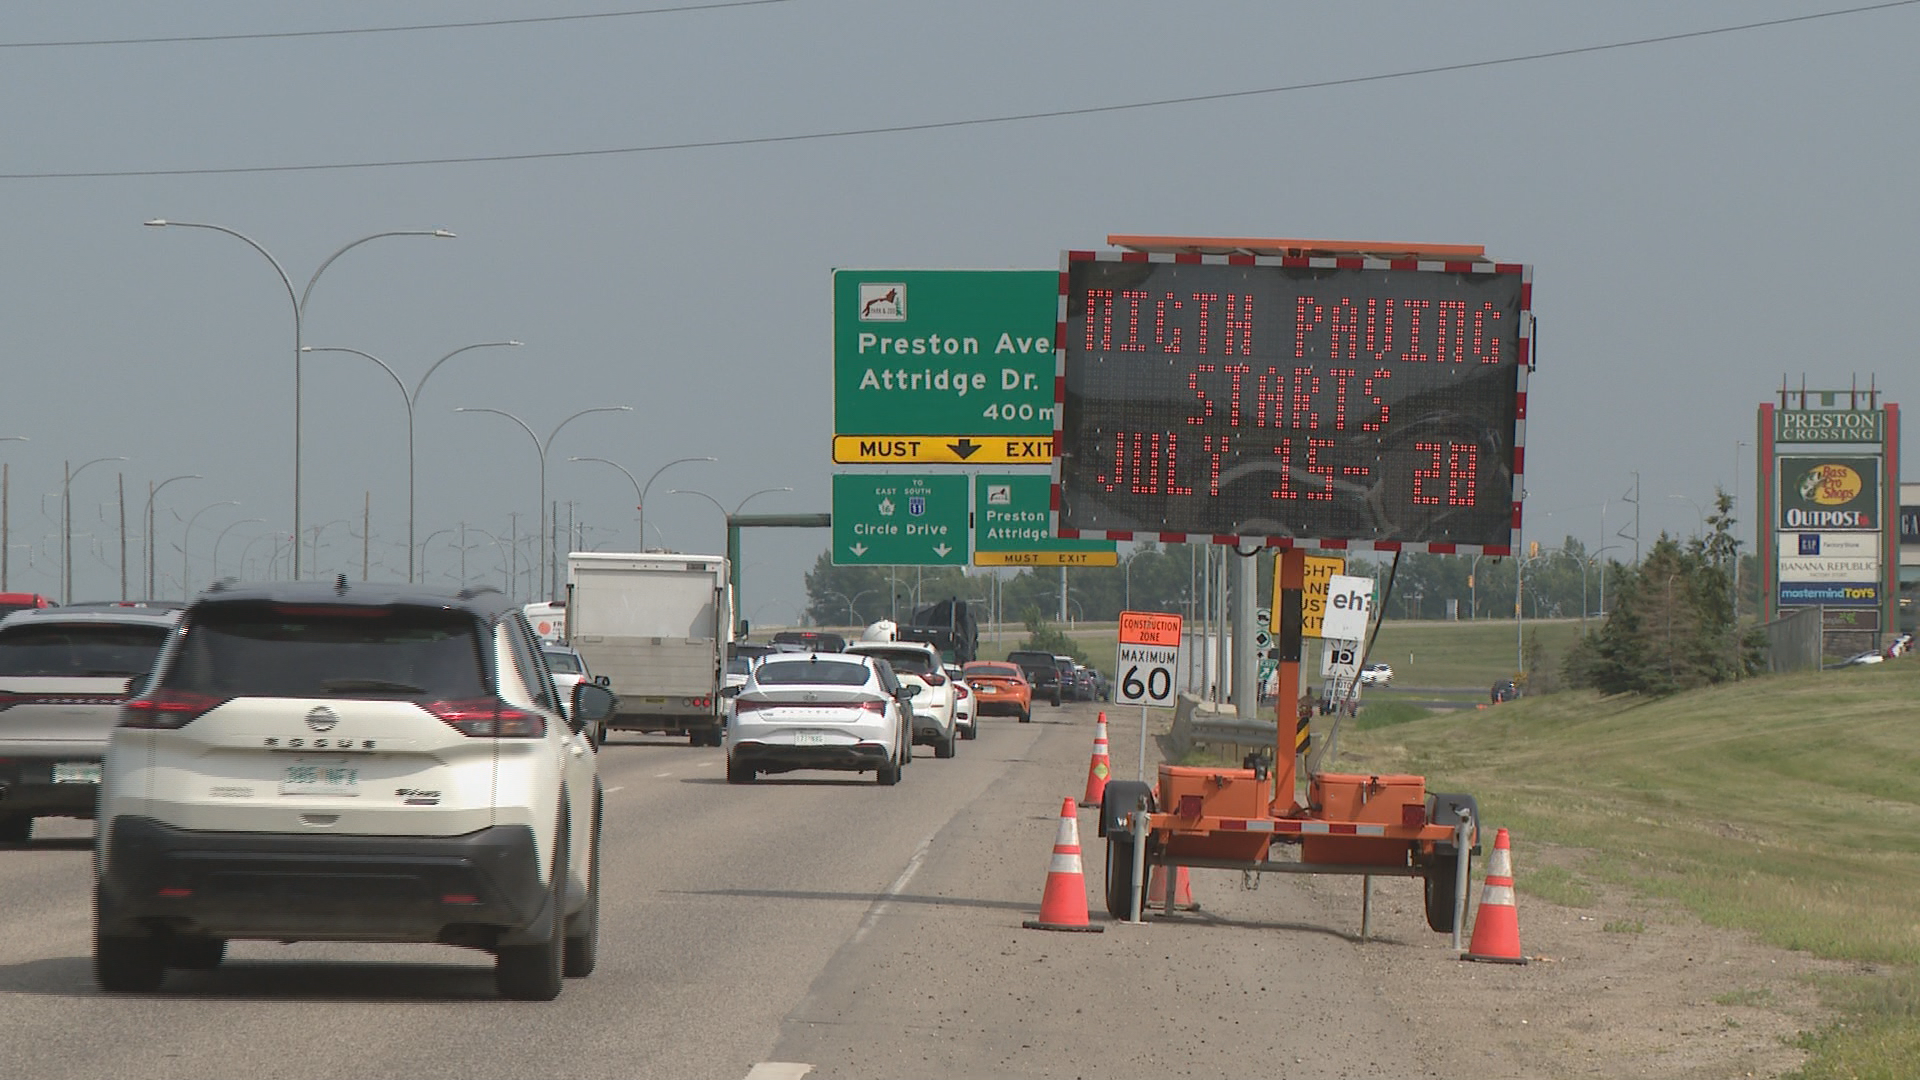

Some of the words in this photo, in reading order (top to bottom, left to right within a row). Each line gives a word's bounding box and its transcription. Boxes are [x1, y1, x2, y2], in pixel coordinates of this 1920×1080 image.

[1295, 296, 1501, 364] PAVING
[858, 332, 979, 355] Preston
[995, 332, 1056, 355] Ave.
[858, 369, 987, 397] Attridge
[1001, 369, 1039, 391] Dr.
[1187, 364, 1392, 432] STARTS
[982, 403, 1034, 421] 400
[1783, 413, 1875, 429] PRESTON
[1782, 428, 1874, 441] CROSSING
[859, 441, 921, 458] MUST
[1006, 442, 1054, 458] EXIT
[1098, 432, 1230, 497] JULY
[1412, 442, 1478, 507] 28
[1822, 465, 1848, 478] Bass
[912, 479, 924, 487] TO
[1823, 477, 1842, 489] Pro
[875, 487, 897, 495] EAST
[904, 487, 932, 495] SOUTH
[1822, 487, 1854, 501] Shops
[882, 505, 892, 513] 16
[913, 504, 923, 513] 11
[986, 510, 1045, 522] Preston
[1786, 508, 1862, 528] OUTPOST
[854, 523, 898, 535] Circle
[906, 523, 948, 535] Drive
[987, 526, 1048, 542] Attridge
[1004, 554, 1039, 563] MUST
[1058, 554, 1087, 563] EXIT
[1781, 562, 1825, 571] BANANA
[1827, 562, 1876, 571] REPUBLIC
[1333, 590, 1372, 612] eh?
[1123, 618, 1179, 633] CONSTRUCTION
[1139, 631, 1161, 642] ZONE
[1121, 648, 1176, 665] MAXIMUM
[1122, 665, 1171, 700] 60
[264, 737, 377, 750] ROGUE
